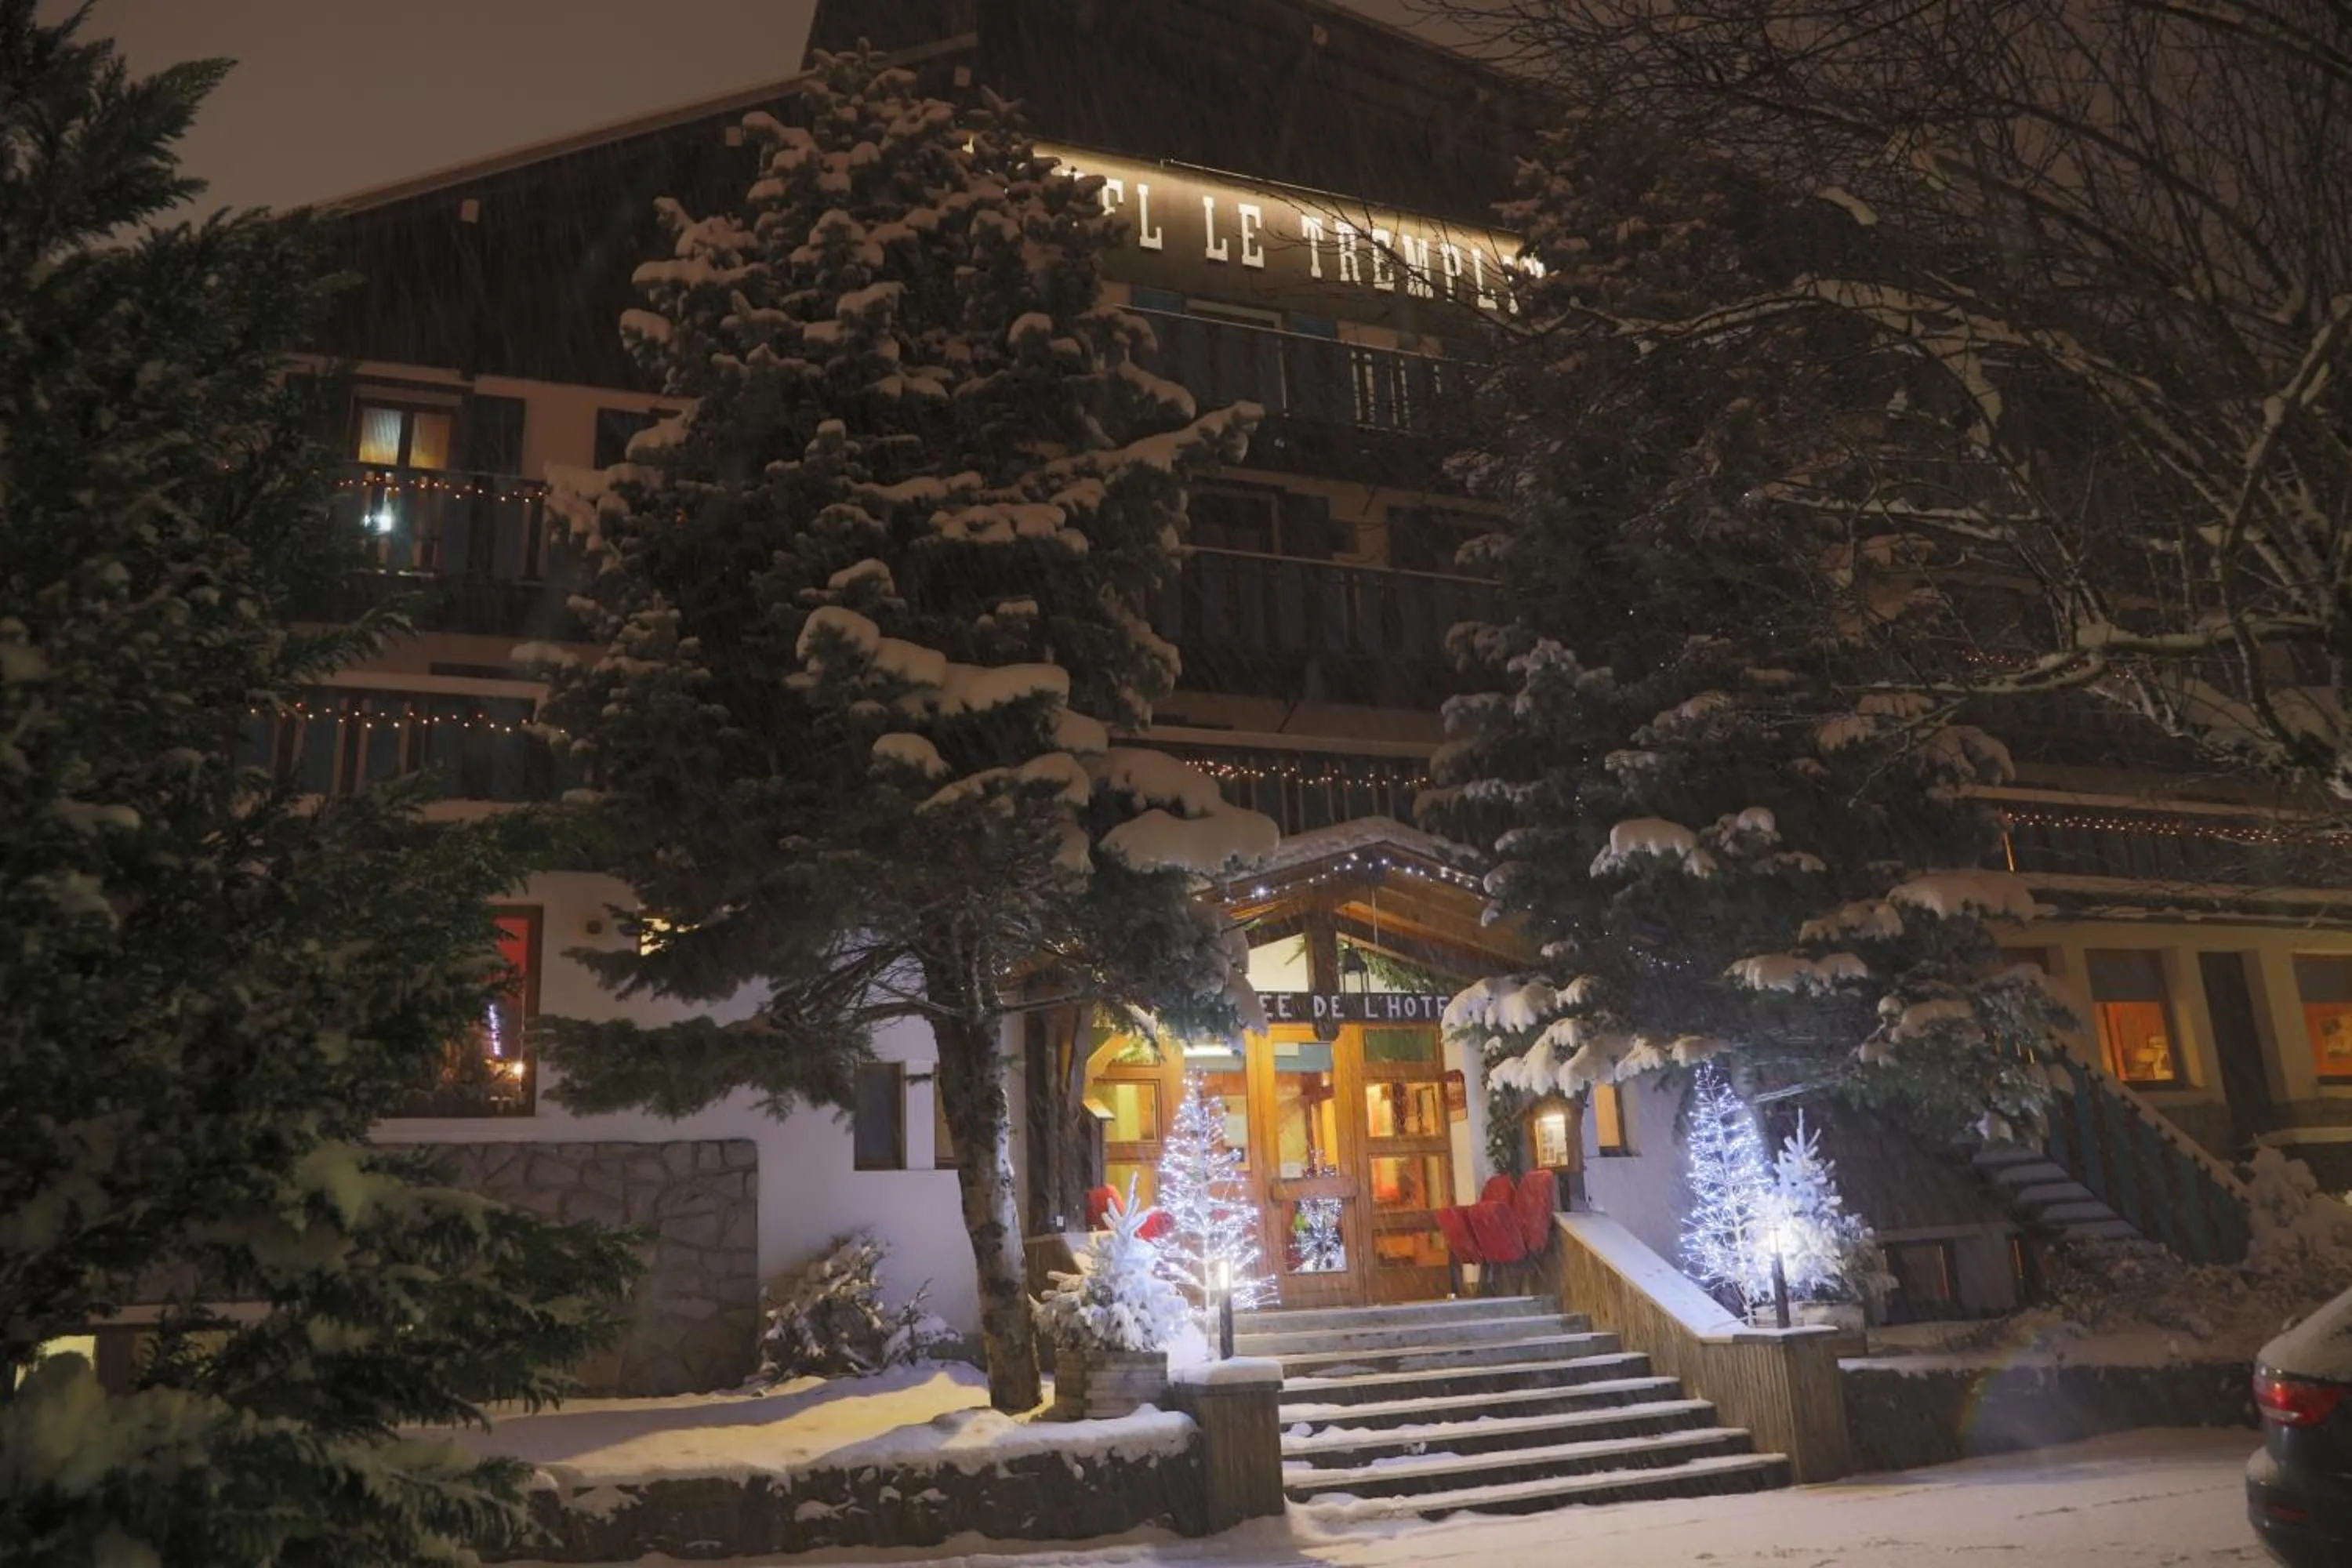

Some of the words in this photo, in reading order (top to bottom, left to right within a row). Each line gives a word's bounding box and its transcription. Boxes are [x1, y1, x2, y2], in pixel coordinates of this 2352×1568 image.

[1203, 195, 1265, 268] LE
[1312, 995, 1345, 1018] DE
[1364, 995, 1450, 1018] L'HOTE
